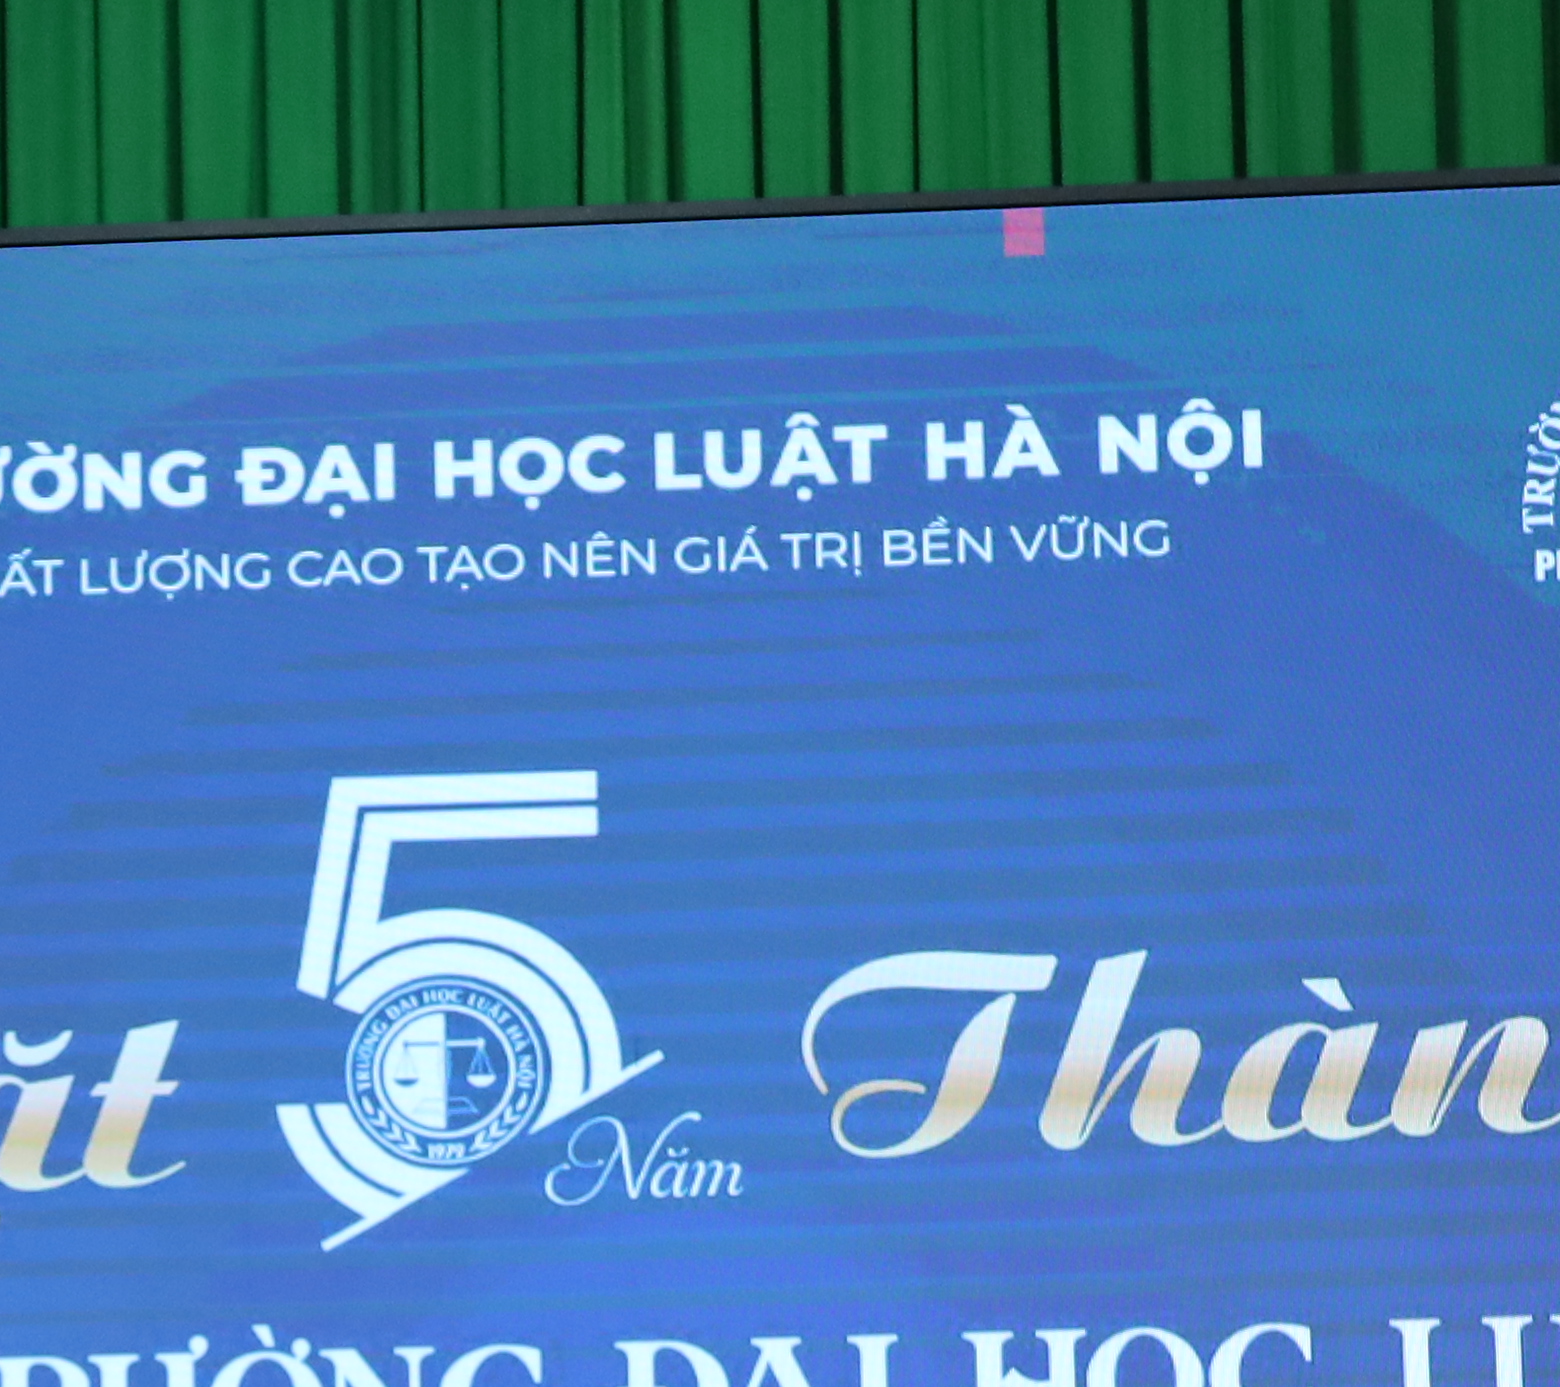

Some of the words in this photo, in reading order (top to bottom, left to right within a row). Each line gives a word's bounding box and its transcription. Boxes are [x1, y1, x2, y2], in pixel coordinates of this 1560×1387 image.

[234, 442, 397, 519] ĐẠI
[432, 434, 626, 511] HỌC
[652, 410, 888, 502] LUẬT
[925, 403, 1061, 481] HÀ
[1097, 396, 1263, 486] NỘI
[81, 549, 271, 601] LƯỢNG
[286, 548, 405, 588] CAO
[416, 542, 526, 591] TẠO
[541, 531, 657, 578] NÊN
[673, 524, 769, 574] GIÁ
[780, 530, 862, 576] TRỊ
[882, 514, 994, 567] BỀN
[1010, 513, 1172, 561] VỮNG
[275, 770, 665, 1252] 5
[544, 1111, 745, 1206] Năm
